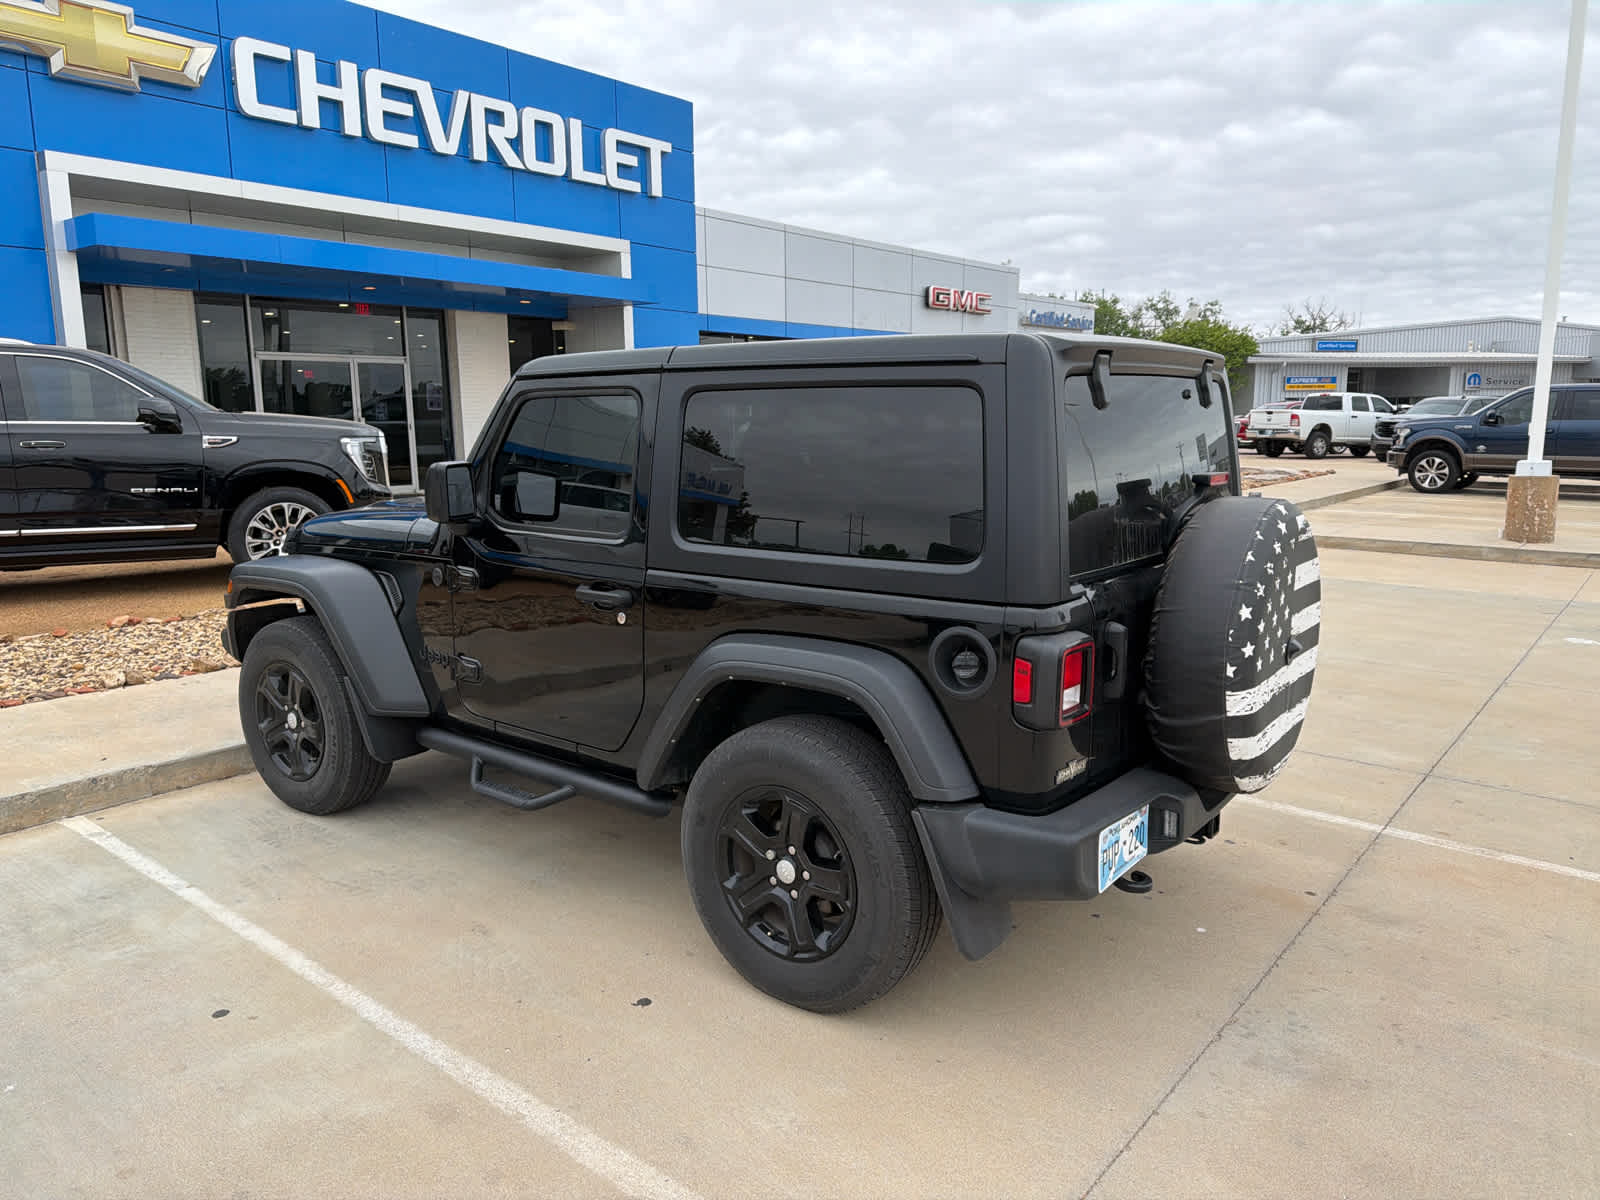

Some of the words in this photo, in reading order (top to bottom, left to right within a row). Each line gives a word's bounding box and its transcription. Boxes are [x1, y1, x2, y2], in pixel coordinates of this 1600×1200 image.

[232, 36, 673, 198] CHEVROLET
[927, 285, 992, 315] GMC
[1029, 309, 1065, 328] Certified
[1066, 312, 1093, 330] Service
[1486, 377, 1523, 386] Service
